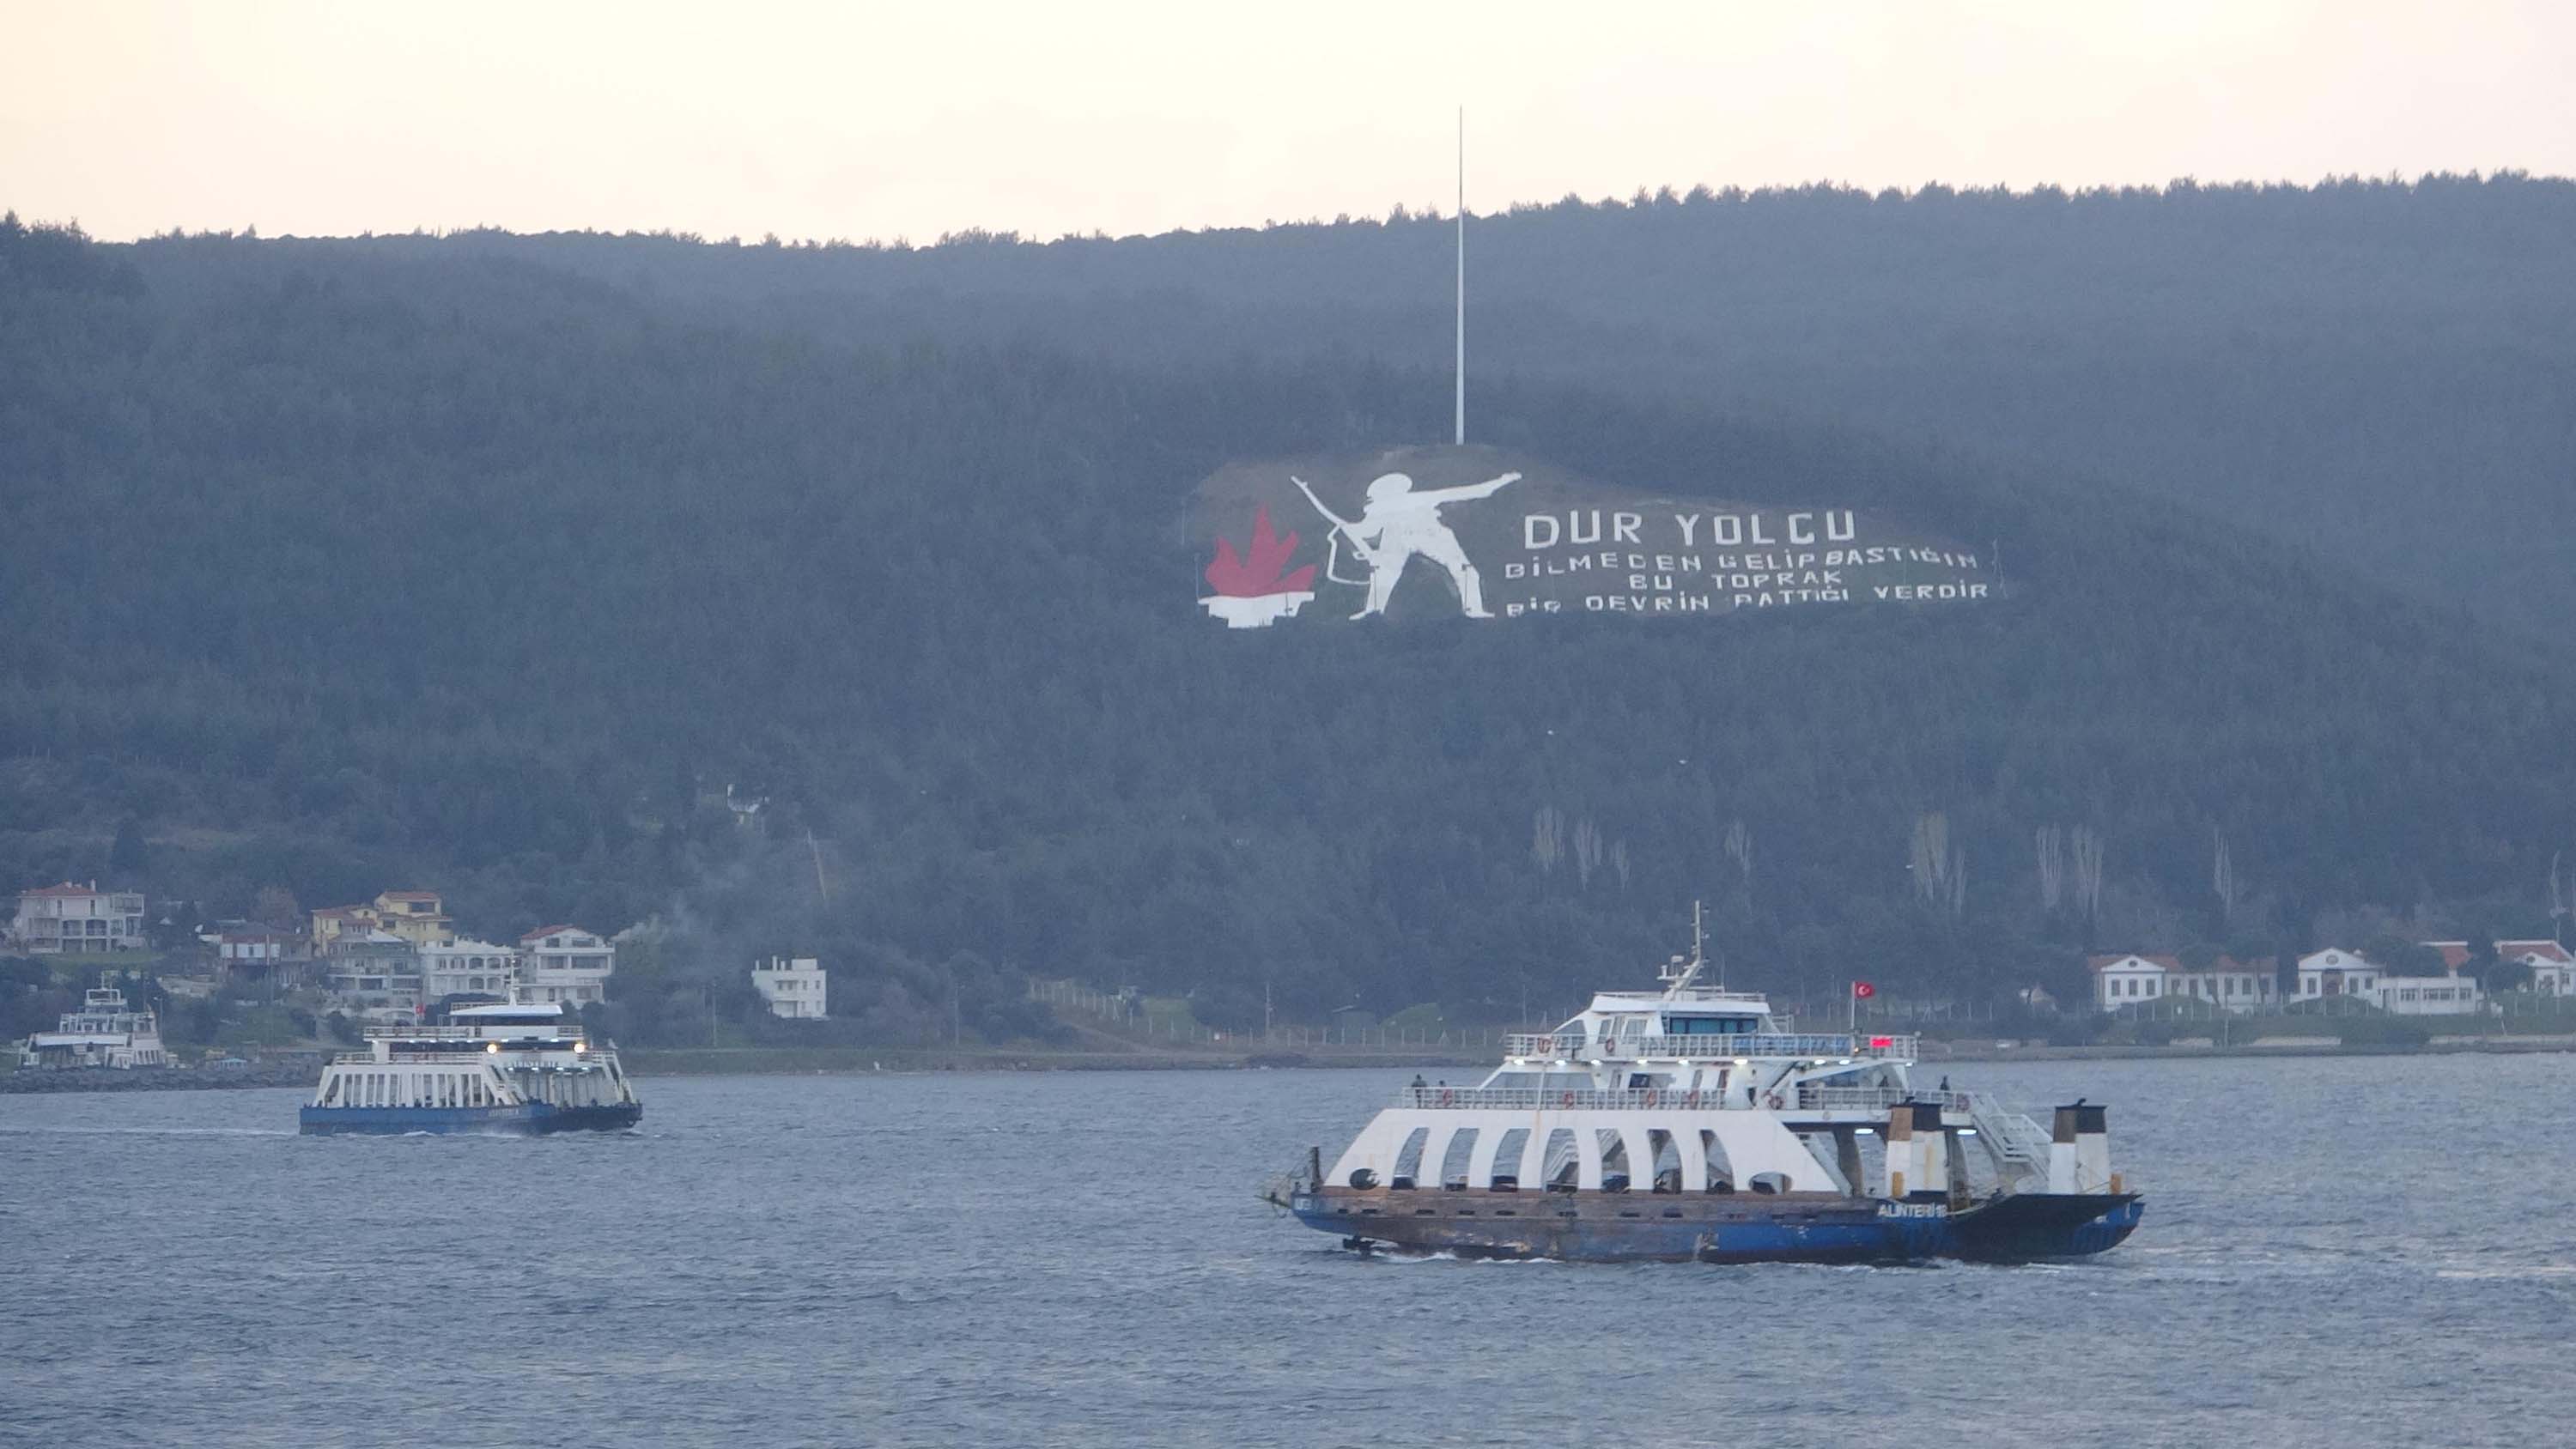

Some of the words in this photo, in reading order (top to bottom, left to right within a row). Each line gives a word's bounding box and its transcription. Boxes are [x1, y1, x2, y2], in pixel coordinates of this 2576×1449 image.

[1524, 510, 1643, 549] DUR
[1675, 510, 1856, 546] YOLCU
[1585, 591, 1710, 612] DEVRİN
[1874, 579, 1988, 599] YERDİR
[1629, 573, 1673, 590] BU
[1710, 570, 1842, 590] TOPRAK
